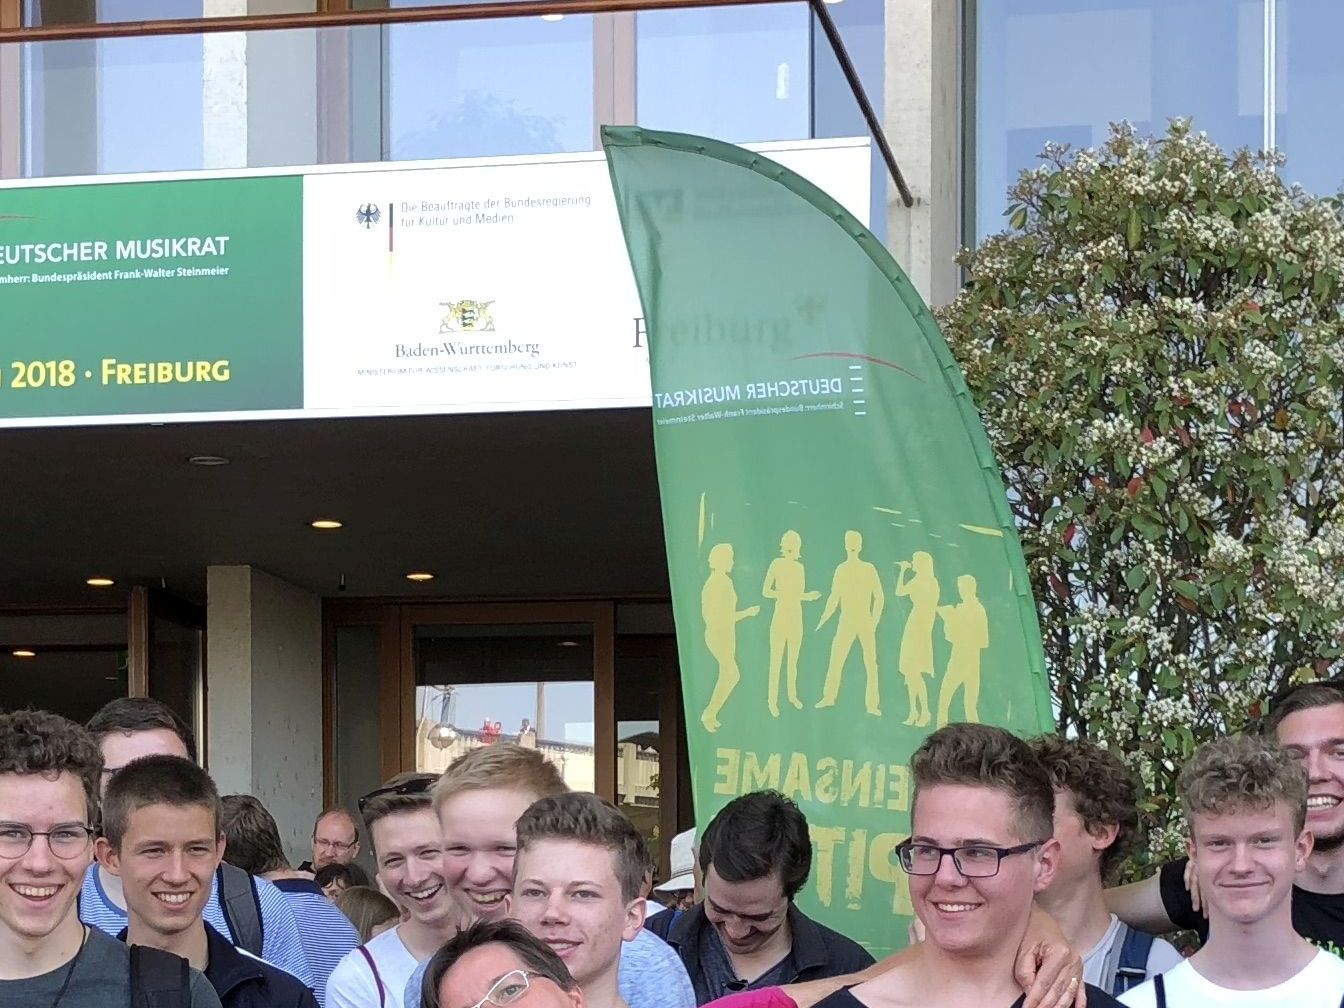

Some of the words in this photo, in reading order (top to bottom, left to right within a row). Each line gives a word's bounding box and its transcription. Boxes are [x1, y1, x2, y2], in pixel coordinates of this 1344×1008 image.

[115, 236, 230, 260] MUSIKRAT
[31, 270, 113, 285] Bundespräsident
[113, 267, 176, 281] Frank-Walter
[176, 265, 230, 277] Steinmeier
[10, 359, 77, 389] 2018
[101, 356, 231, 387] FREIBURG
